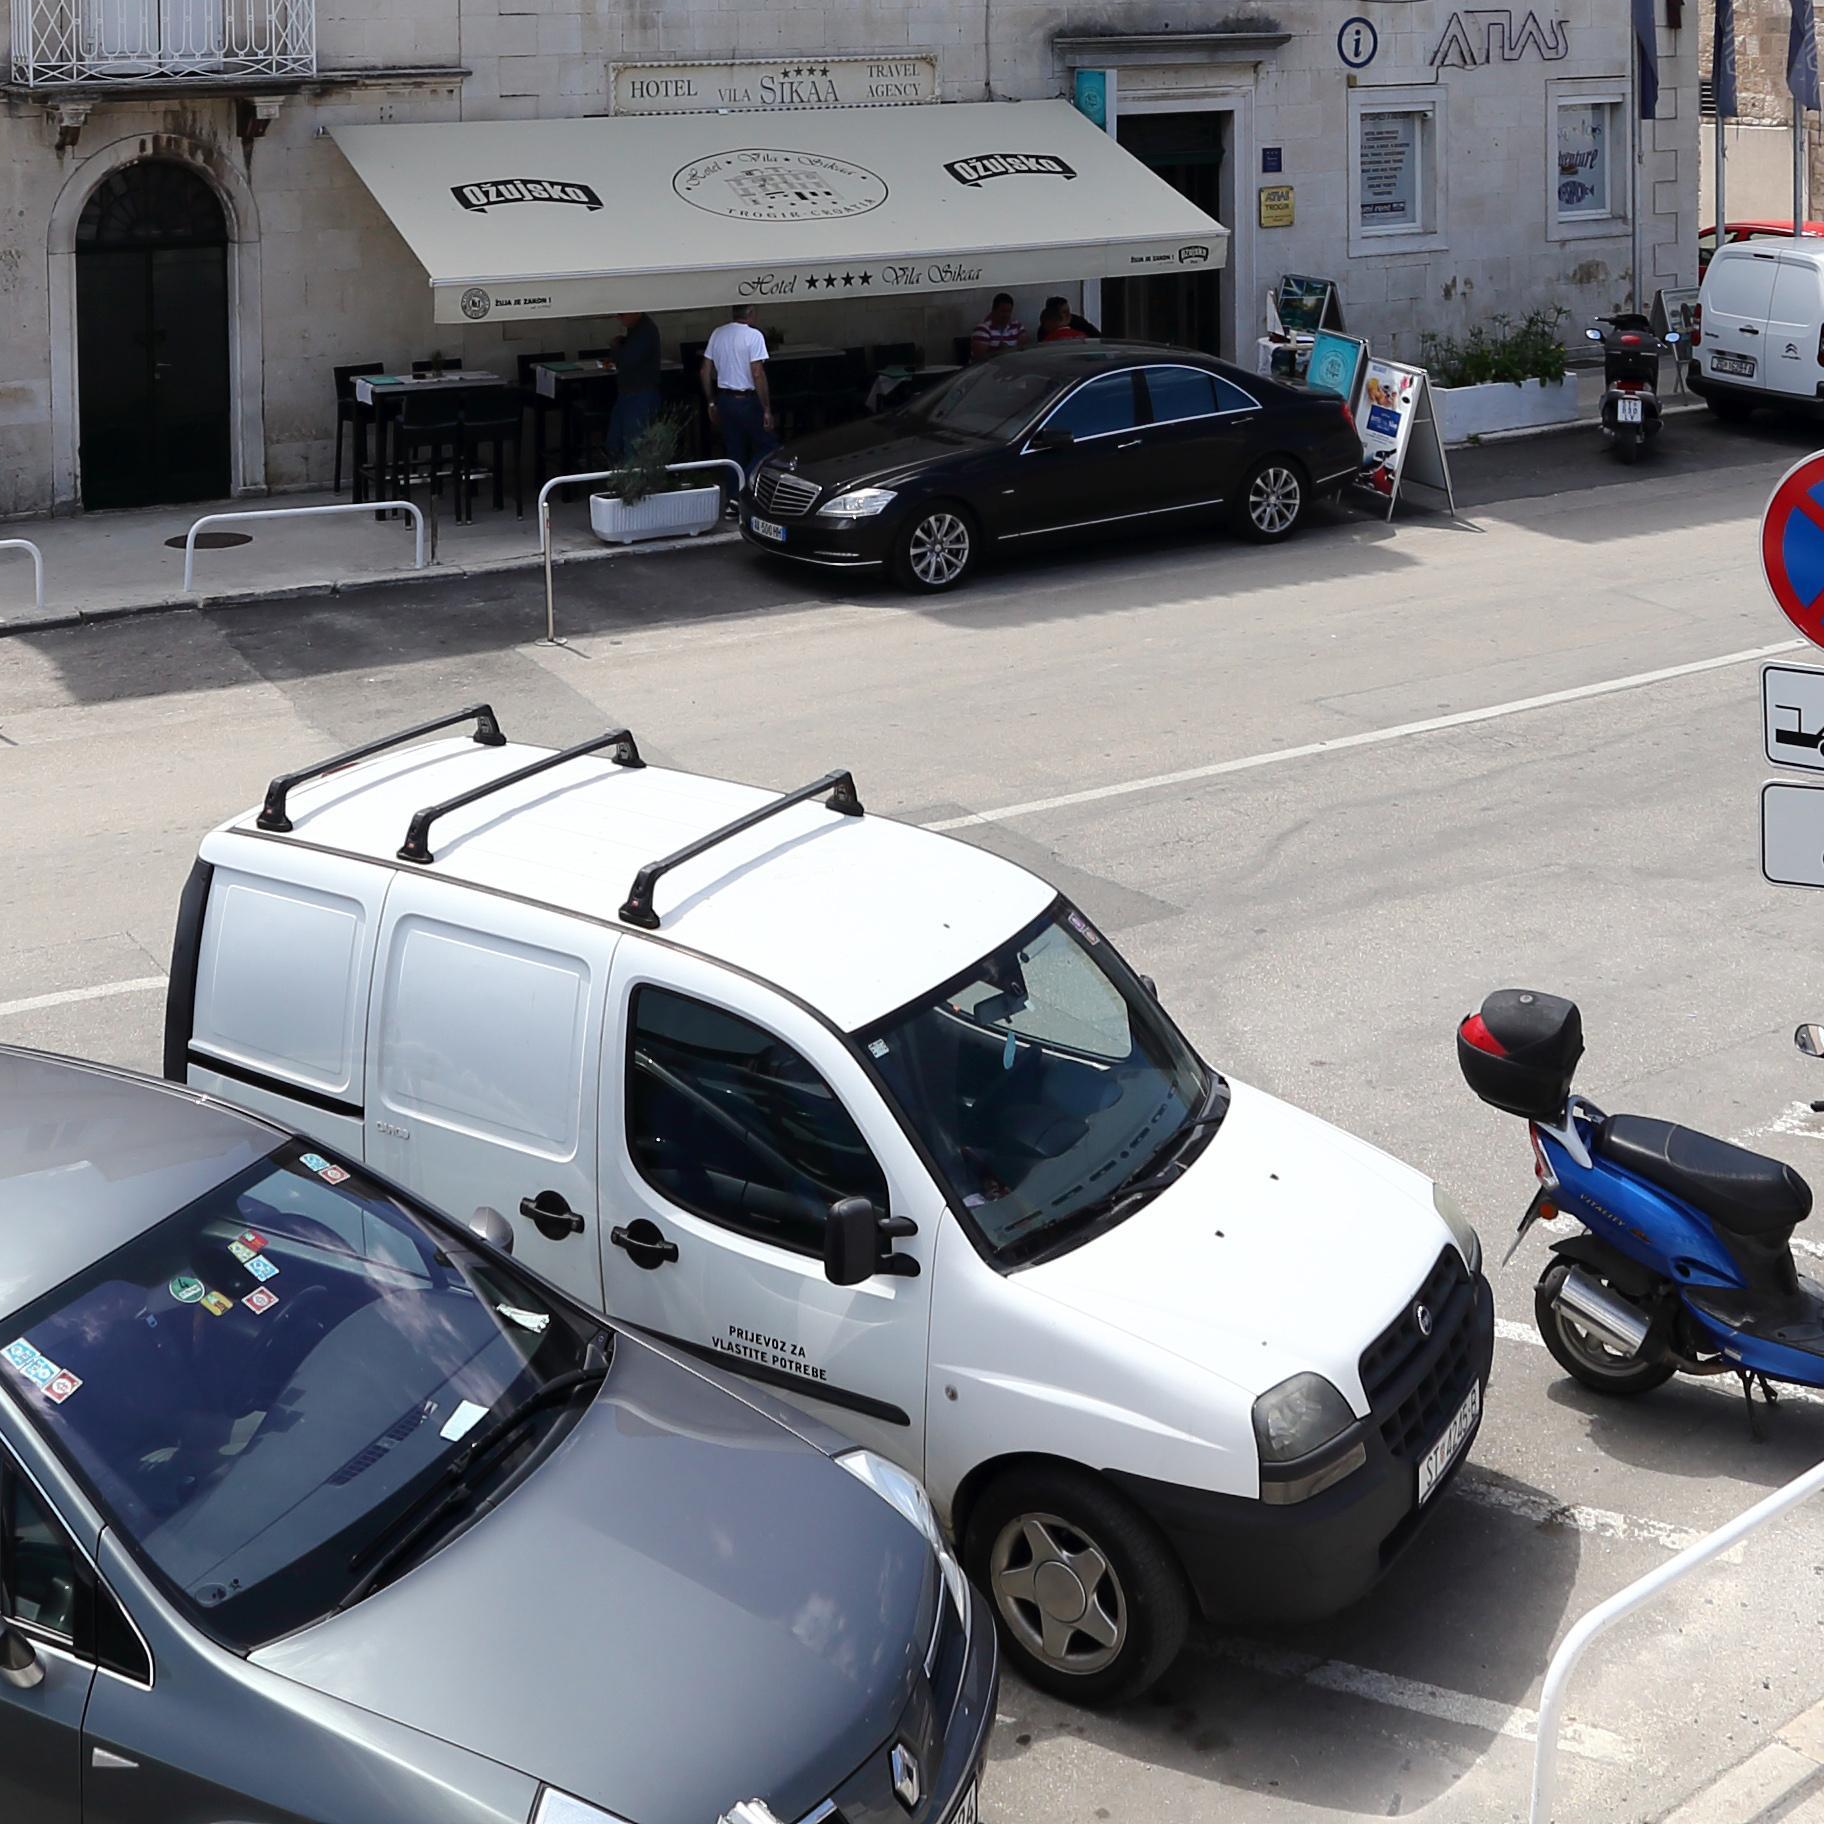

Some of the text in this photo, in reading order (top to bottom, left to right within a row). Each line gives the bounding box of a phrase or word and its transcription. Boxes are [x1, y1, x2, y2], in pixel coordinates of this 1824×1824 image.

[867, 63, 921, 78] TRAVEL
[630, 74, 841, 105] HOTEL VILA SIKAA
[866, 82, 921, 98] AGENCY
[952, 153, 1064, 182] Ožujsko
[463, 179, 591, 207] Ožujsko
[737, 262, 983, 297] Hotel Vila Sikaa
[729, 1325, 806, 1358] PRIJEVOZ ZA
[712, 1336, 827, 1381] VLASTITE POTREBE
[1426, 1446, 1439, 1487] ST
